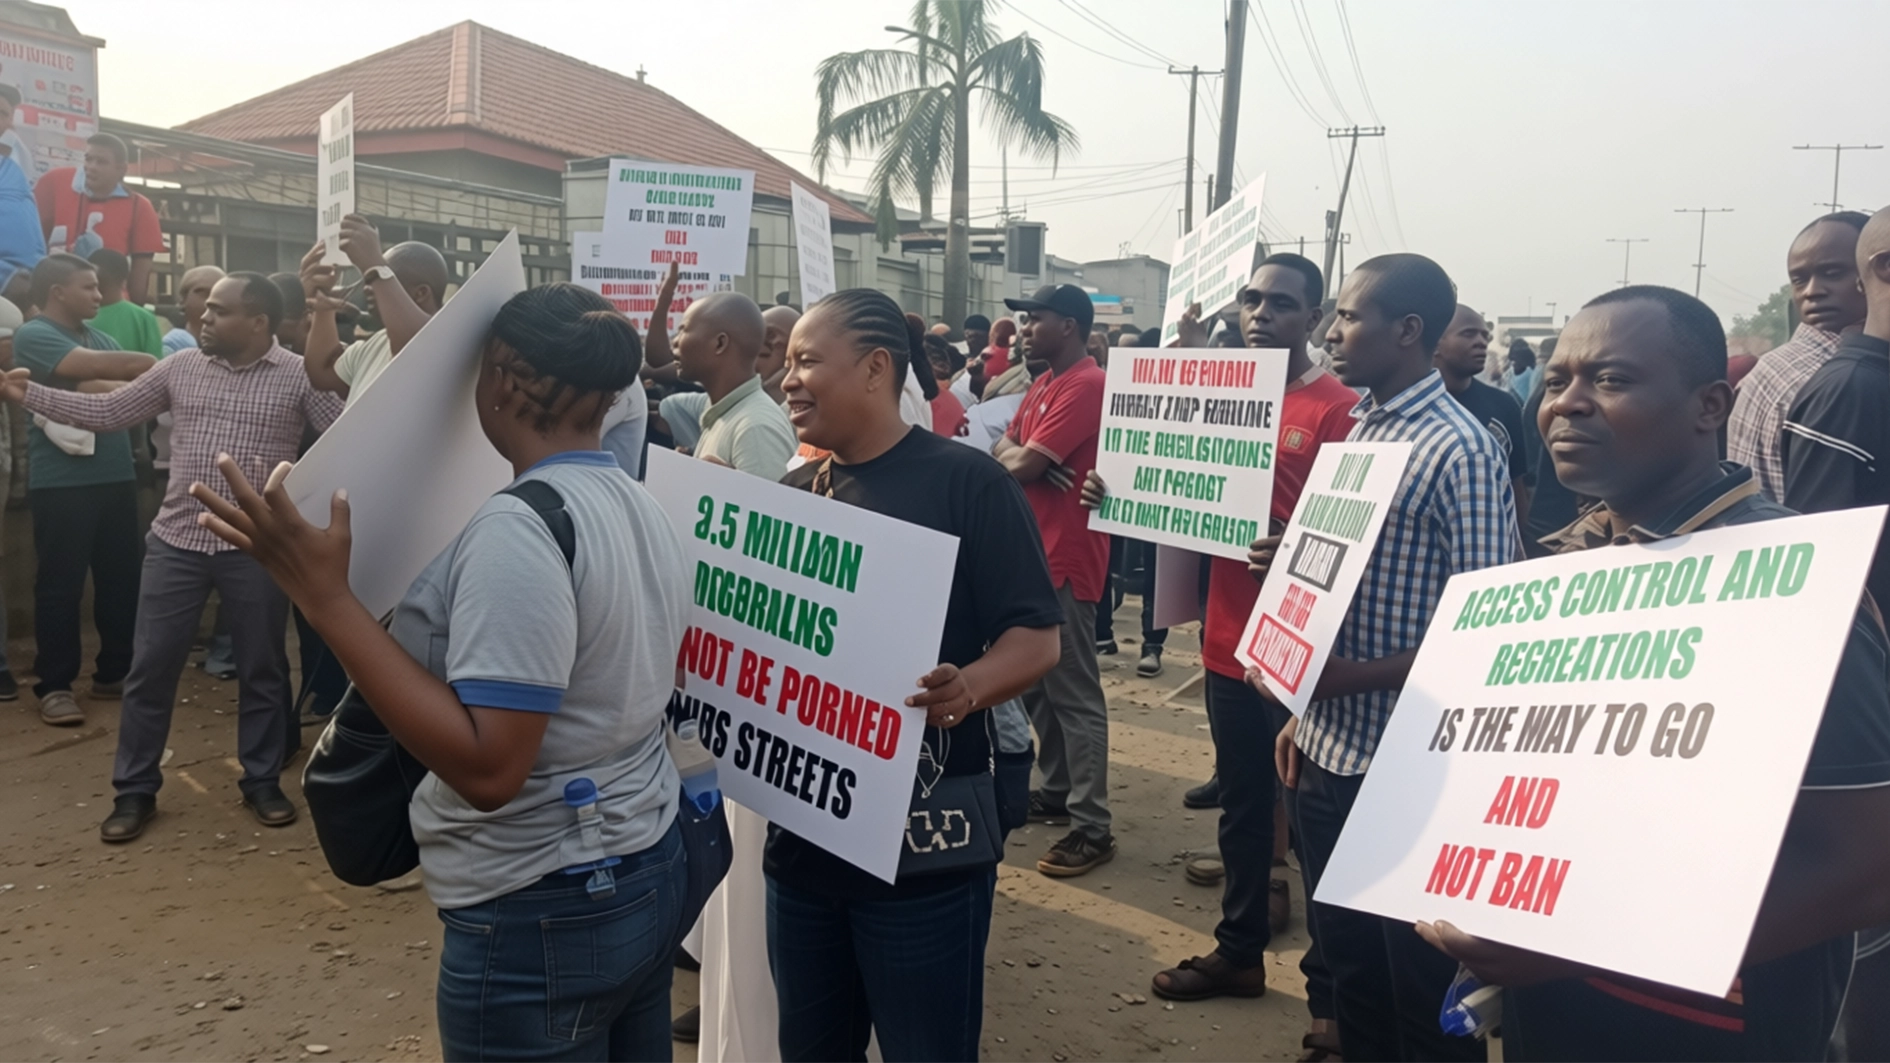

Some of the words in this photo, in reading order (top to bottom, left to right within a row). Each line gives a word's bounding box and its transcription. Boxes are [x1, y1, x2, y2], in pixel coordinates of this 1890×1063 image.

[1452, 576, 1560, 631] ACCESS
[1559, 555, 1713, 618] CONTROL
[1717, 542, 1815, 602] AND
[1485, 626, 1703, 686] REGREATIONS
[676, 626, 734, 688] NOT
[736, 648, 774, 706] BE
[777, 665, 902, 760] PORNED
[1428, 708, 1464, 752] IS
[1462, 706, 1519, 752] THE
[1594, 702, 1648, 756] TO
[1649, 702, 1715, 759] GO
[734, 722, 856, 819] STREETS
[1483, 775, 1560, 829] AND
[1425, 843, 1496, 900] NOT
[1488, 852, 1571, 916] BAN
